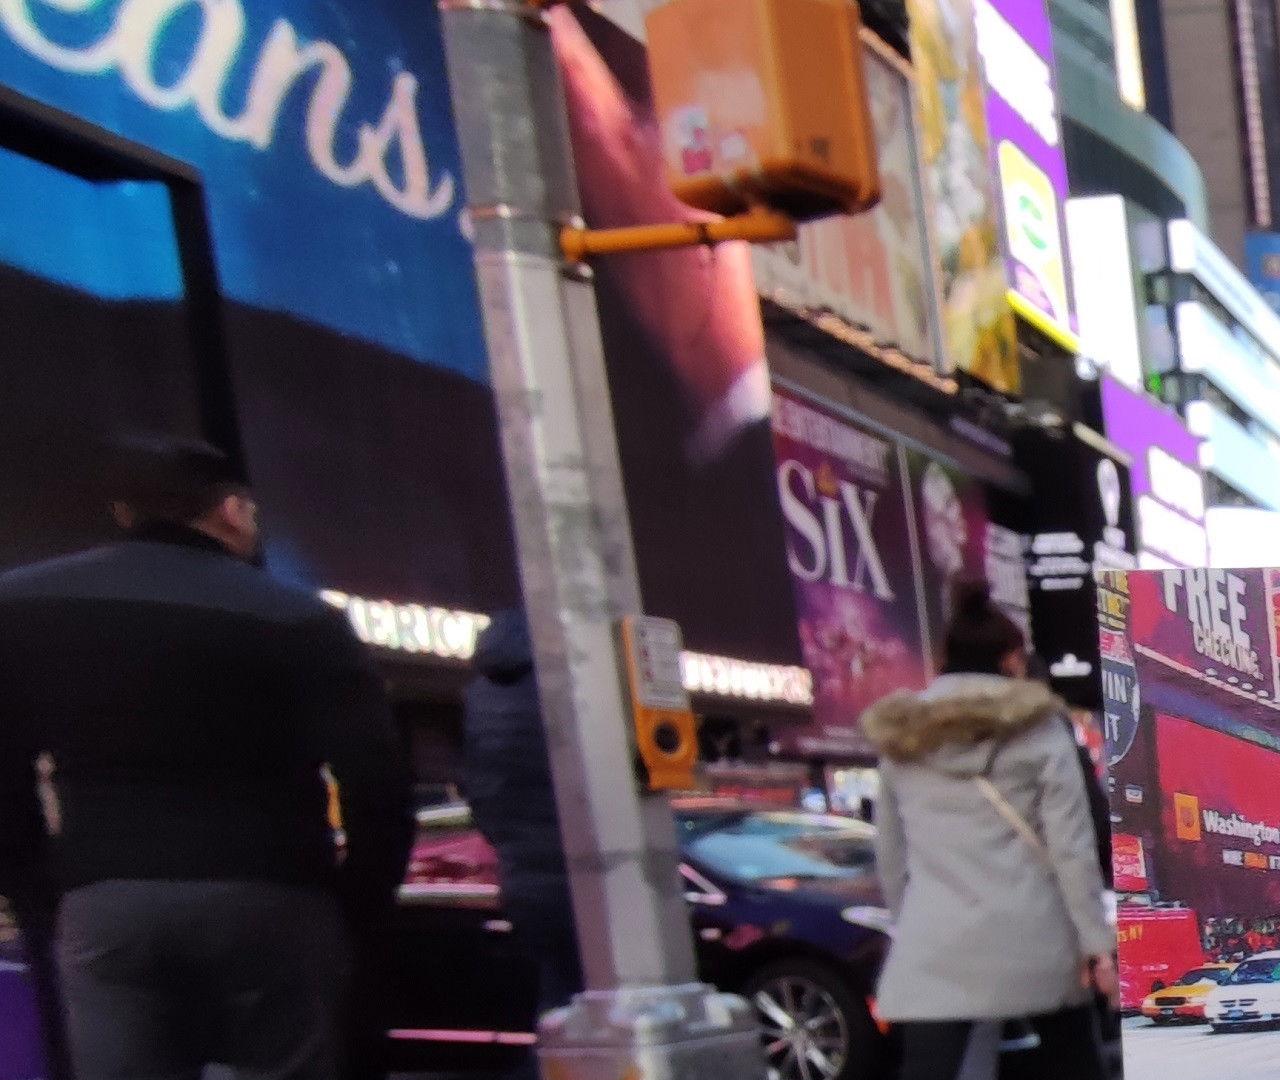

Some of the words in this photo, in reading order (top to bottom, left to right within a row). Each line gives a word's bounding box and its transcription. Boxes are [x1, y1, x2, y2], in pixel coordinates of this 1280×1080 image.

[777, 458, 895, 601] SIX
[1161, 568, 1251, 652] FREE
[1202, 809, 1280, 847] Washington
